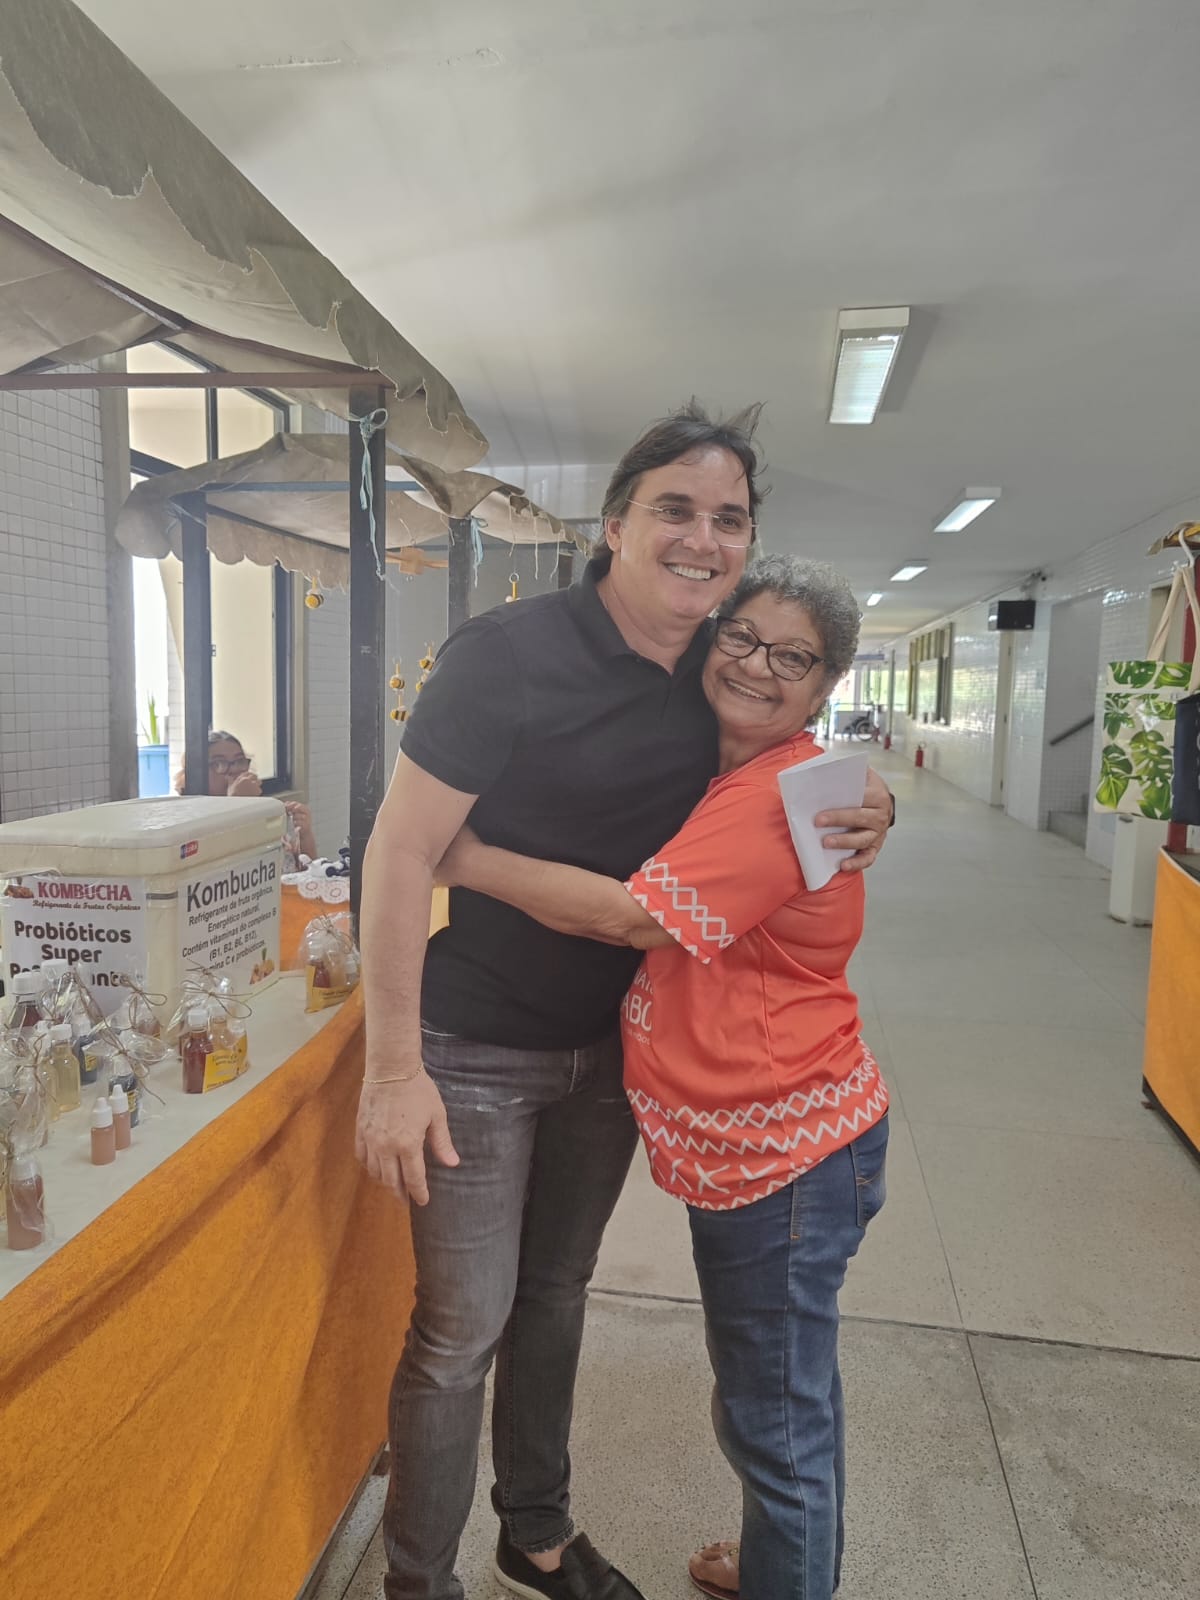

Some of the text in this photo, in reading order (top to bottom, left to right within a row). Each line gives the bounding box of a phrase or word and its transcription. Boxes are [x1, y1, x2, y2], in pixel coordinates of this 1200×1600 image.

[37, 881, 132, 901] KOMBUCHA
[187, 860, 276, 913] Kombucha
[189, 905, 228, 926] Refrigerante
[229, 901, 237, 910] de
[14, 920, 132, 943] Probióticos
[210, 927, 239, 946] vitaminas
[272, 906, 277, 917] B
[41, 944, 102, 966] Super
[225, 955, 231, 966] C
